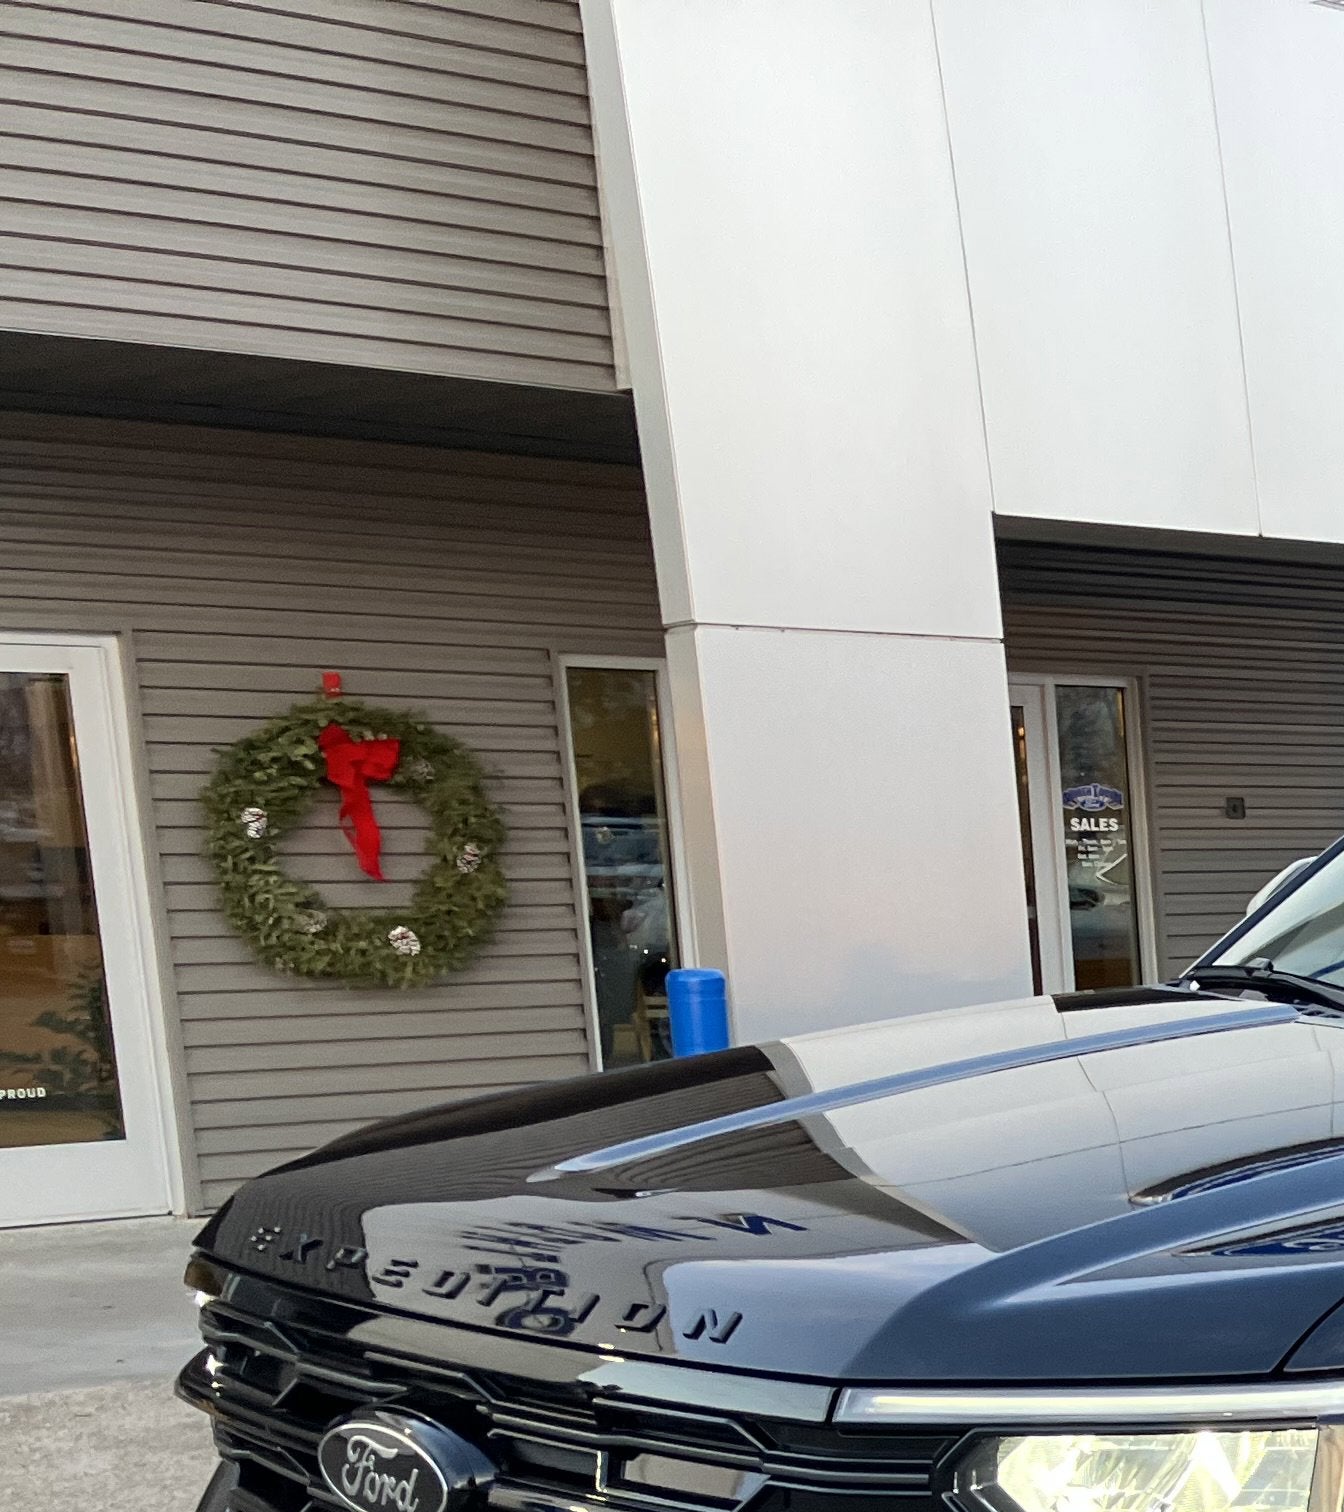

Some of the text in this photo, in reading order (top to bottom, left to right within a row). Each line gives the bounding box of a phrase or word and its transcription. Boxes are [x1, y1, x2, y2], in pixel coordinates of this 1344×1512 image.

[1070, 817, 1119, 831] SALES
[0, 1087, 46, 1100] PROUD
[250, 1225, 743, 1344] EXPEDITION
